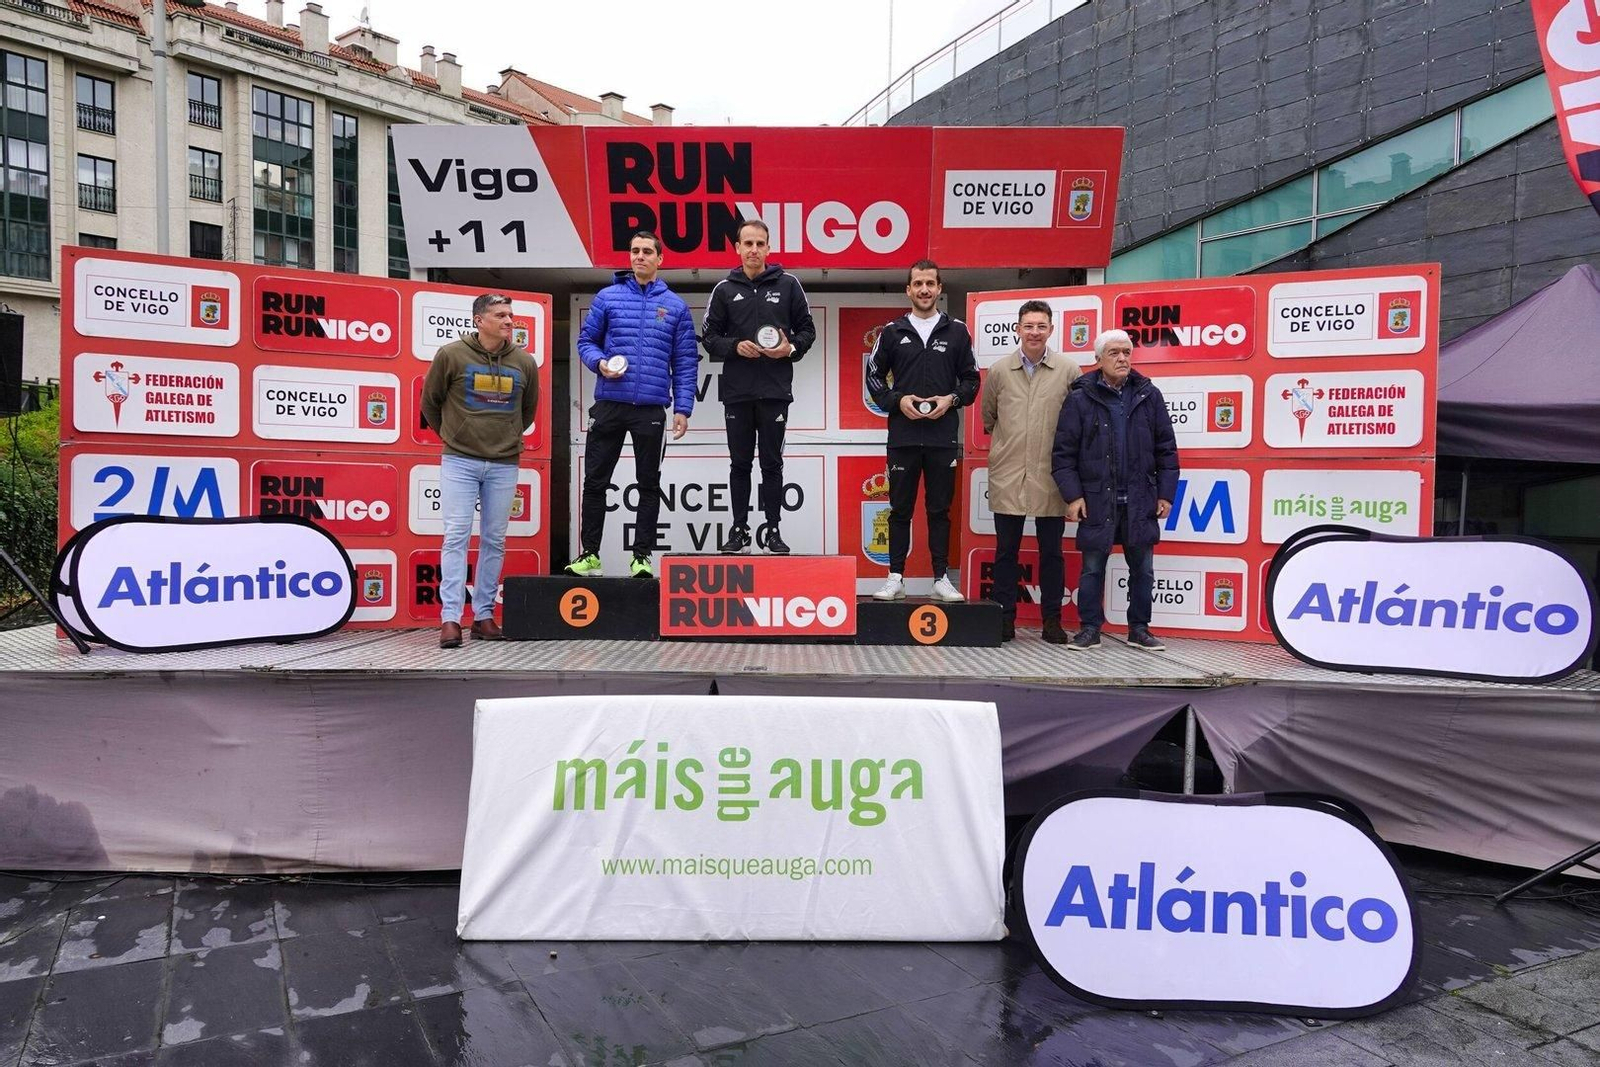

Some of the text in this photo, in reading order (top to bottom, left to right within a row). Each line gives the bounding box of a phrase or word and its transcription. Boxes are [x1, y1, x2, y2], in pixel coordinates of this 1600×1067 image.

[606, 142, 752, 195] RUN
[408, 159, 538, 200] Vigo
[953, 183, 1046, 196] CONCELLO
[963, 201, 1033, 215] DE VIGO
[94, 285, 179, 302] CONCELLO
[104, 300, 169, 315] DE VIGO
[262, 291, 325, 316] RUN
[1280, 303, 1365, 319] CONCELLO
[428, 315, 478, 329] CONCEL
[1122, 305, 1181, 326] RUN
[436, 328, 453, 338] DE
[984, 322, 1019, 334] CONC
[1290, 319, 1355, 333] DE VIGO
[992, 335, 1009, 346] DE
[145, 373, 224, 390] FEDERACIÓN
[145, 392, 213, 407] GALEGA DE
[266, 389, 347, 404] CONCELLO
[1328, 384, 1406, 400] FEDERACIÓN
[145, 409, 215, 424] ATLETISMO
[276, 404, 338, 418] DE VIGO
[1328, 404, 1393, 418] GALEGA DE
[1327, 422, 1396, 436] ATLETISMO
[260, 475, 324, 497] RUN
[1273, 493, 1327, 517] máis
[1350, 499, 1408, 523] auga
[97, 560, 343, 608] Atlántico
[669, 564, 754, 594] RUN
[571, 595, 587, 619] 2
[1287, 581, 1579, 635] Atlántico
[920, 612, 936, 637] 3
[552, 739, 923, 827] máis que auga
[602, 854, 872, 880] www.maisqueauga.com
[1044, 862, 1399, 943] Atlántico
